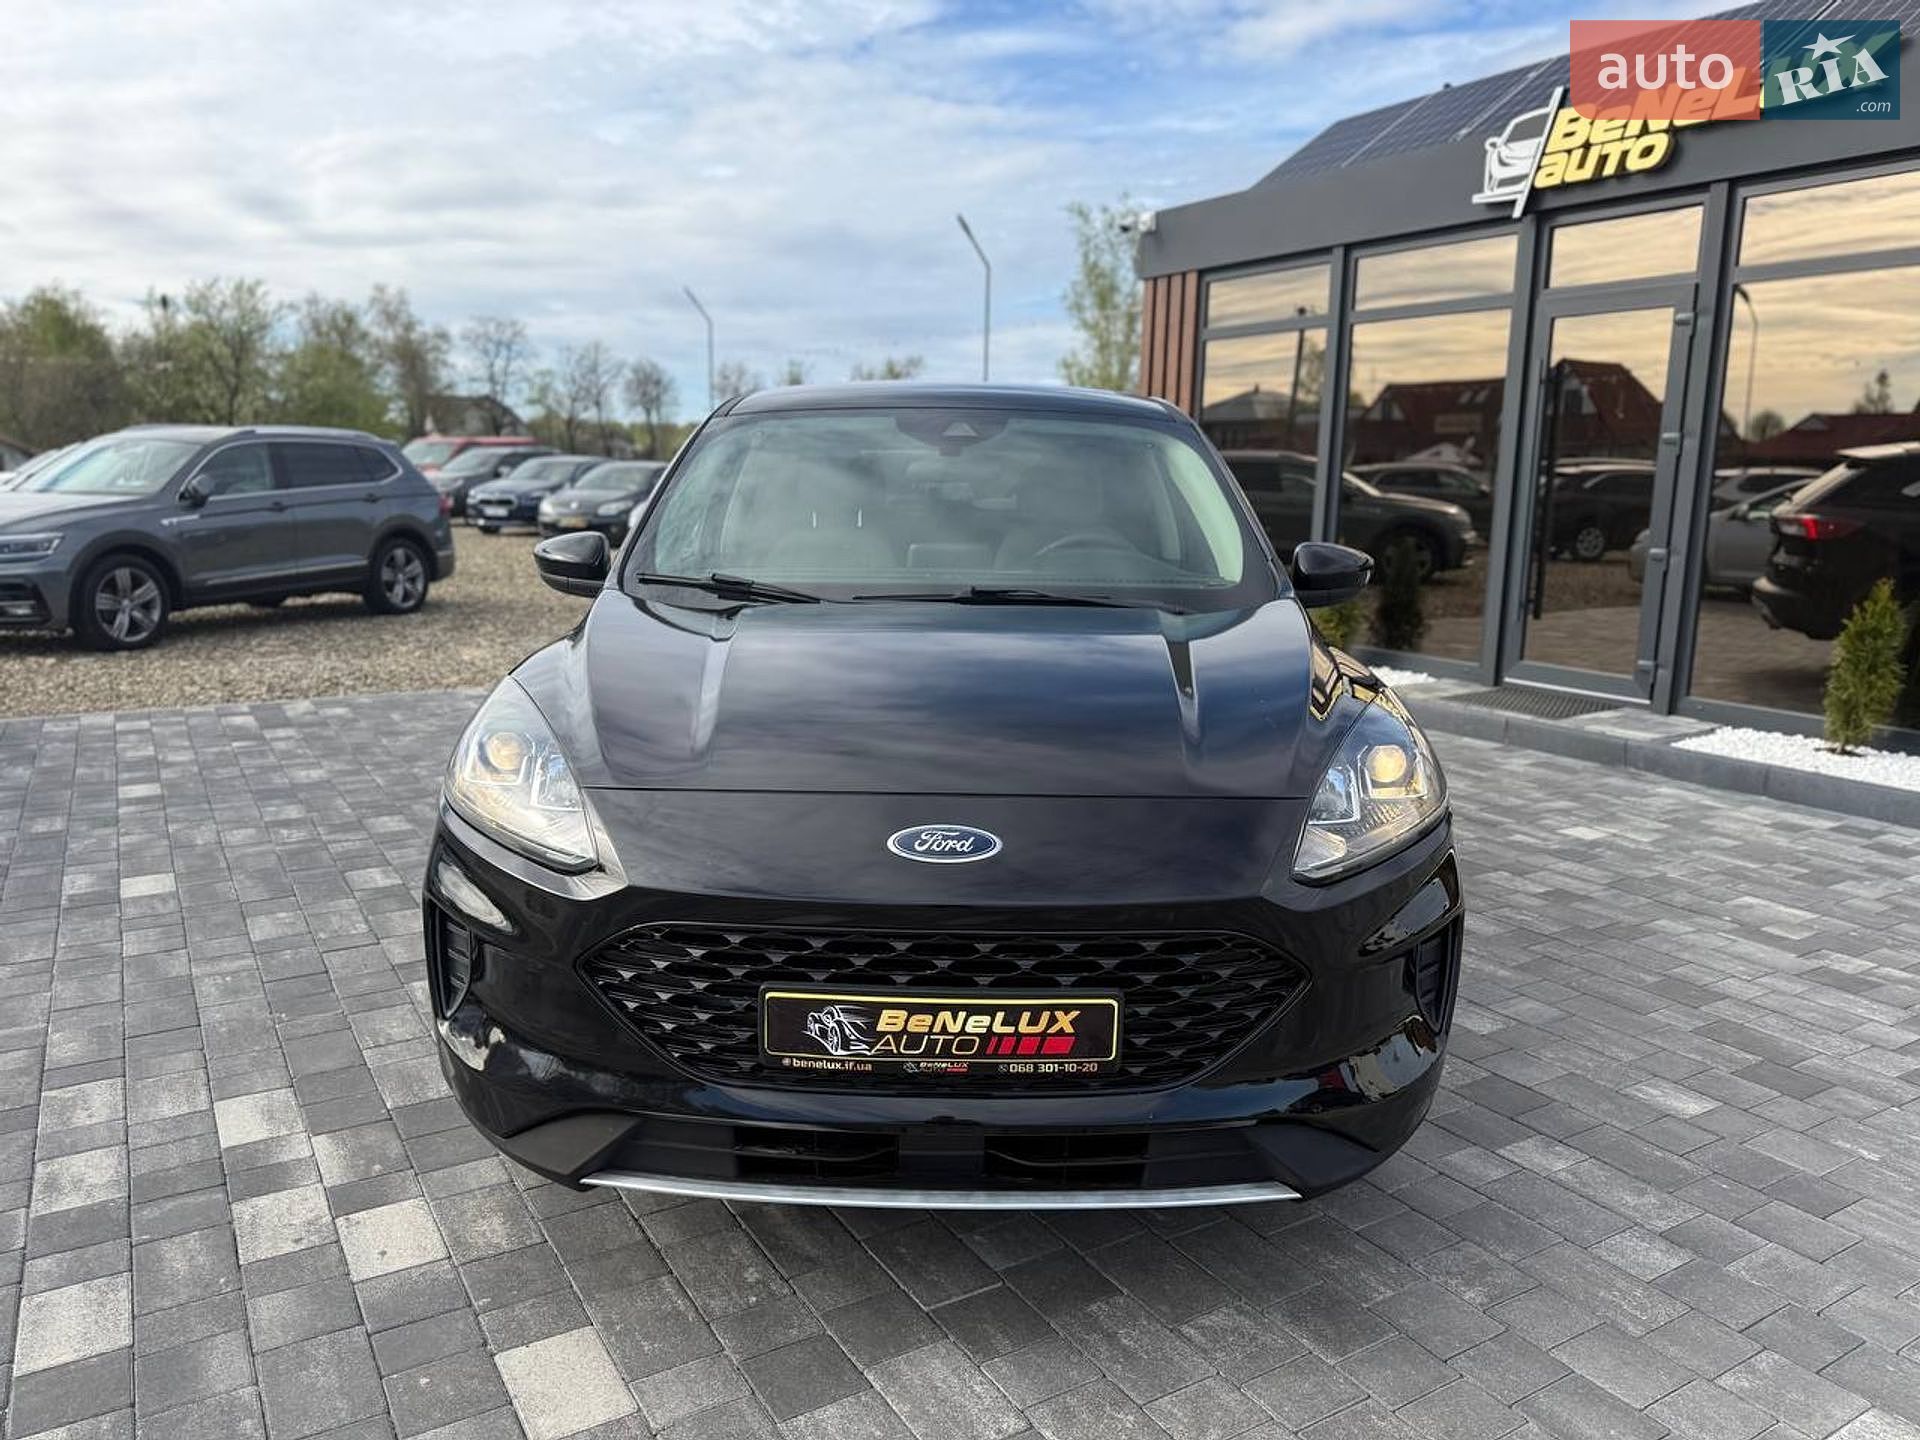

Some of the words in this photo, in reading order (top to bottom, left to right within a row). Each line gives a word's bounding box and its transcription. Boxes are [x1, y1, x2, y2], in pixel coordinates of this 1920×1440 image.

[914, 831, 975, 852] Ford
[876, 1009, 1081, 1034] BeNeLUX
[871, 1034, 980, 1055] AUTO
[792, 1057, 872, 1071] benelux.if.ua
[1009, 1063, 1034, 1073] 068
[1037, 1062, 1098, 1073] 301-10-20
